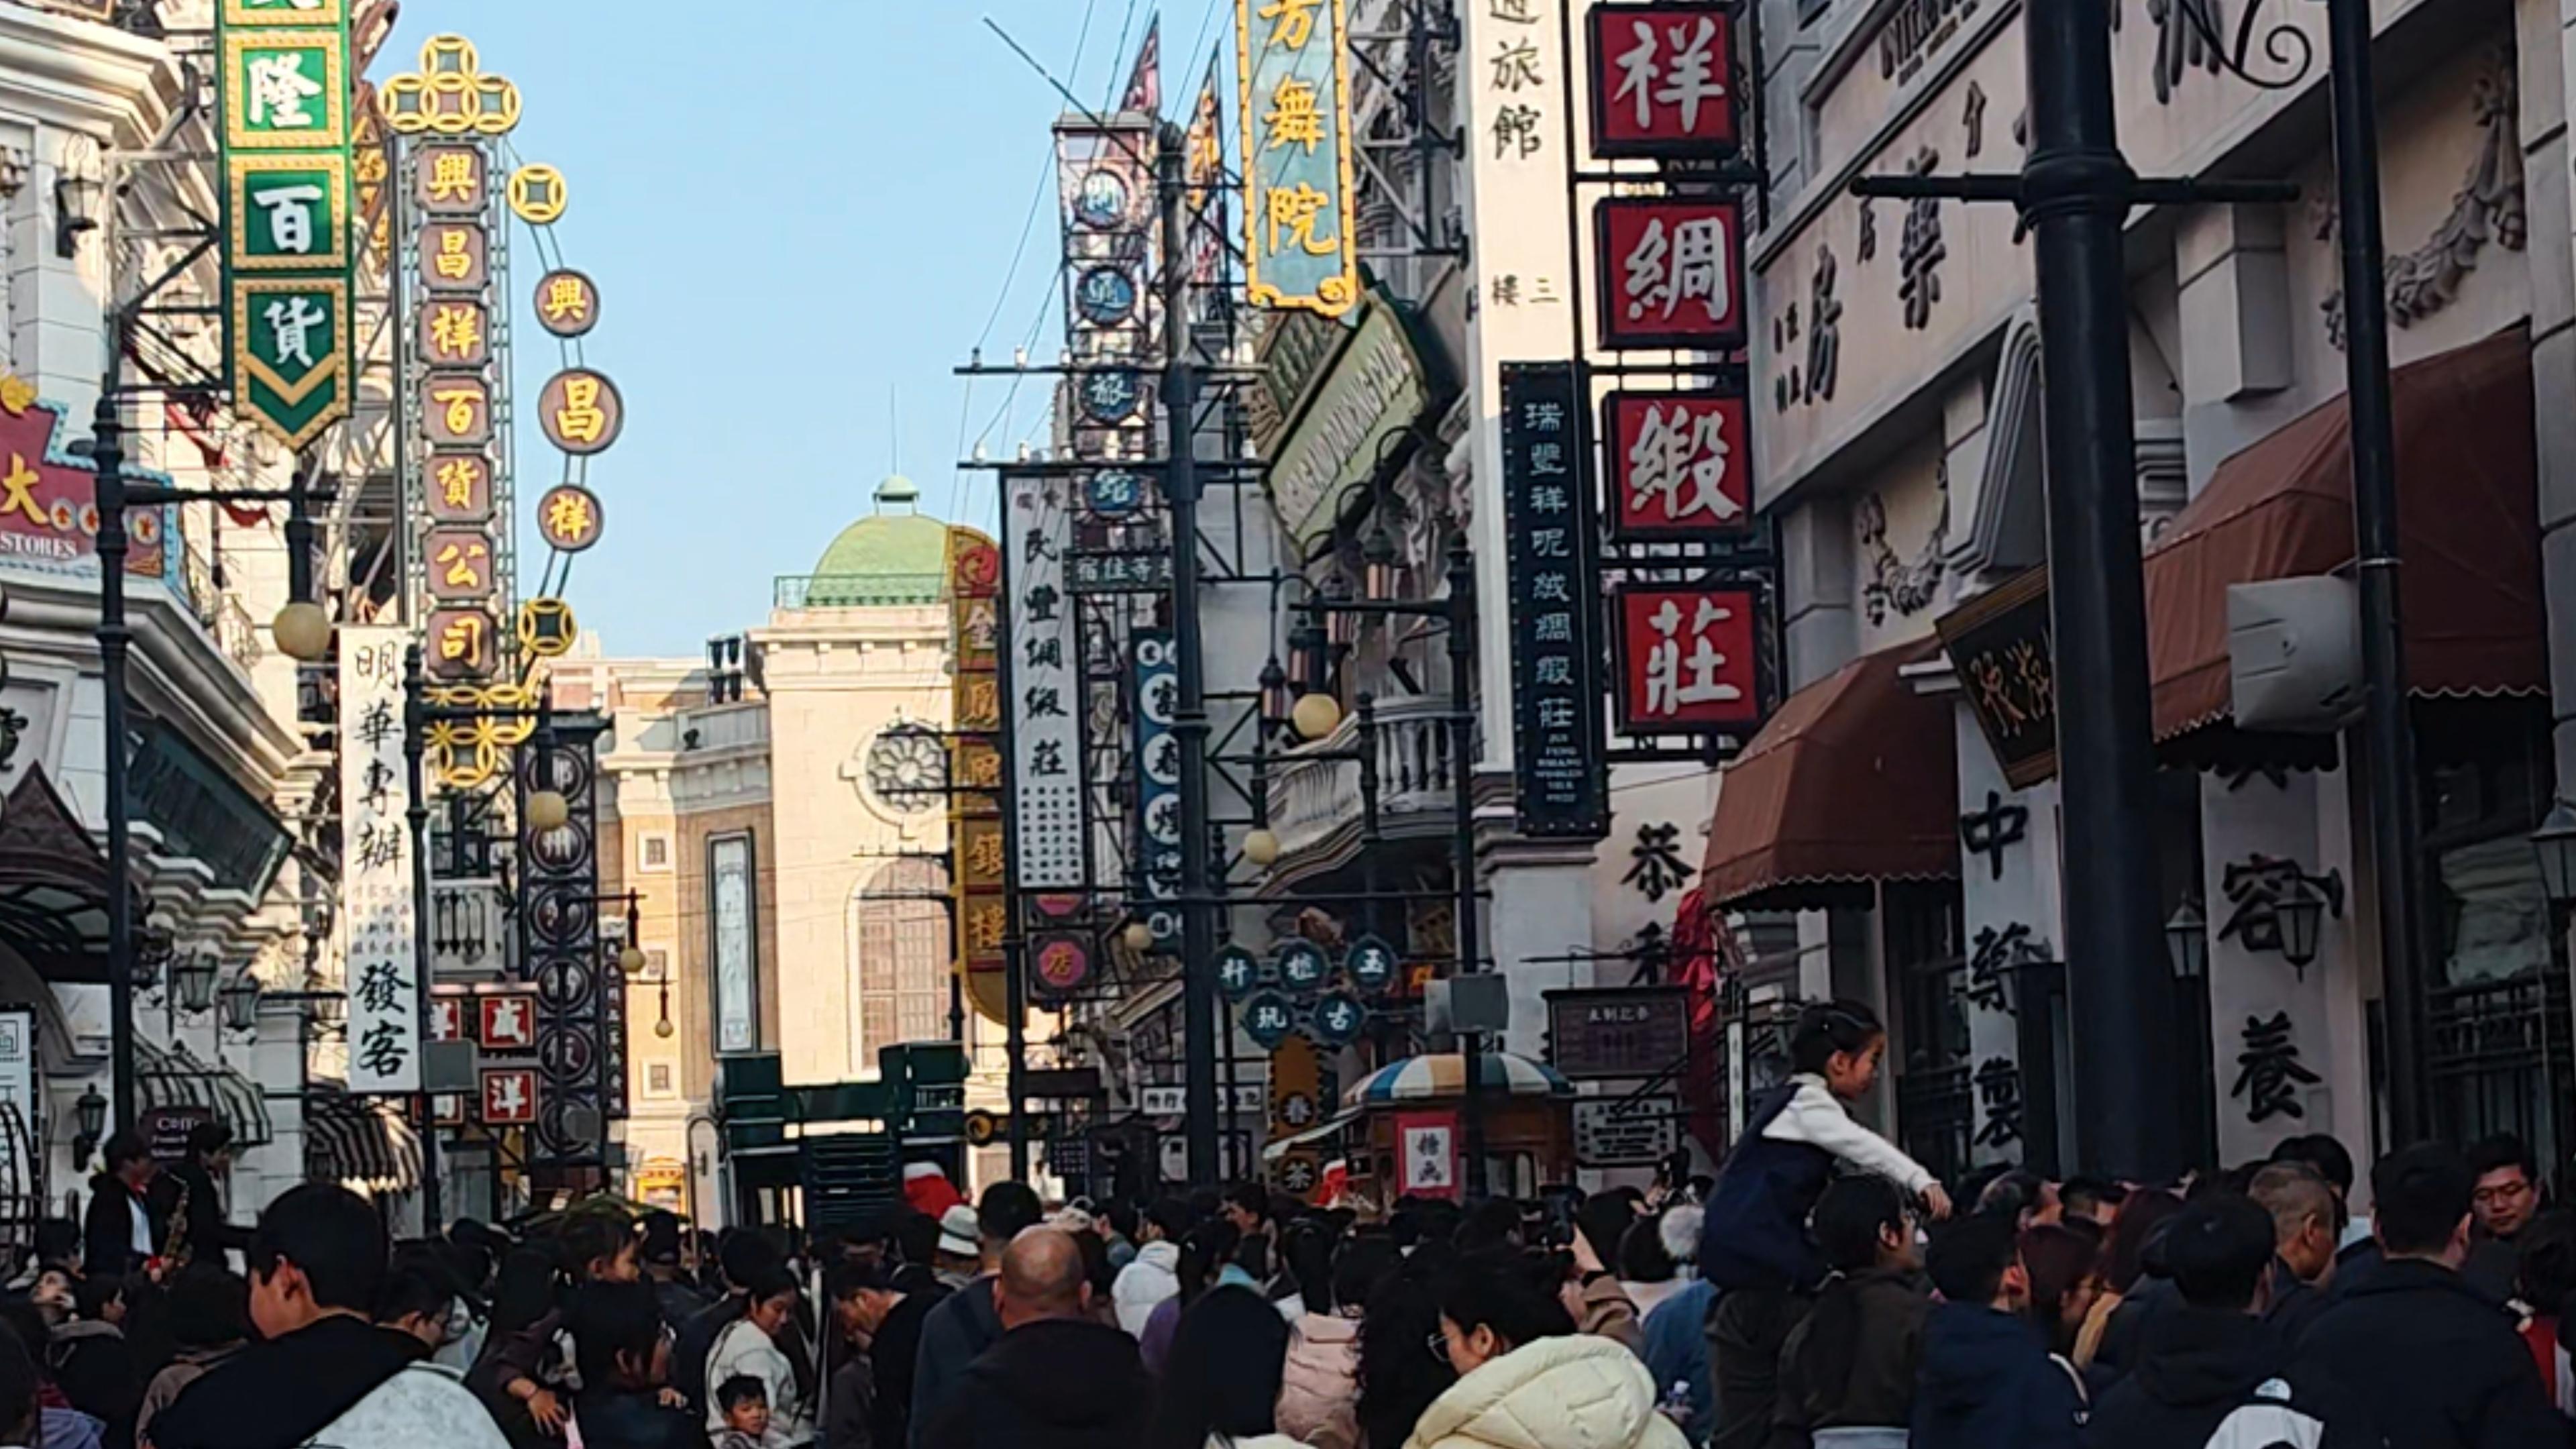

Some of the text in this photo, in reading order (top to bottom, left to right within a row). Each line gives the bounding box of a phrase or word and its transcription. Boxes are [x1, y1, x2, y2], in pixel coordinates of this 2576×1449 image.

[248, 0, 326, 368] 隆百貨
[1613, 16, 1746, 716] 祥綢緞莊
[427, 152, 484, 667] 興昌祥百貨公司
[542, 278, 605, 539] 興昌祥
